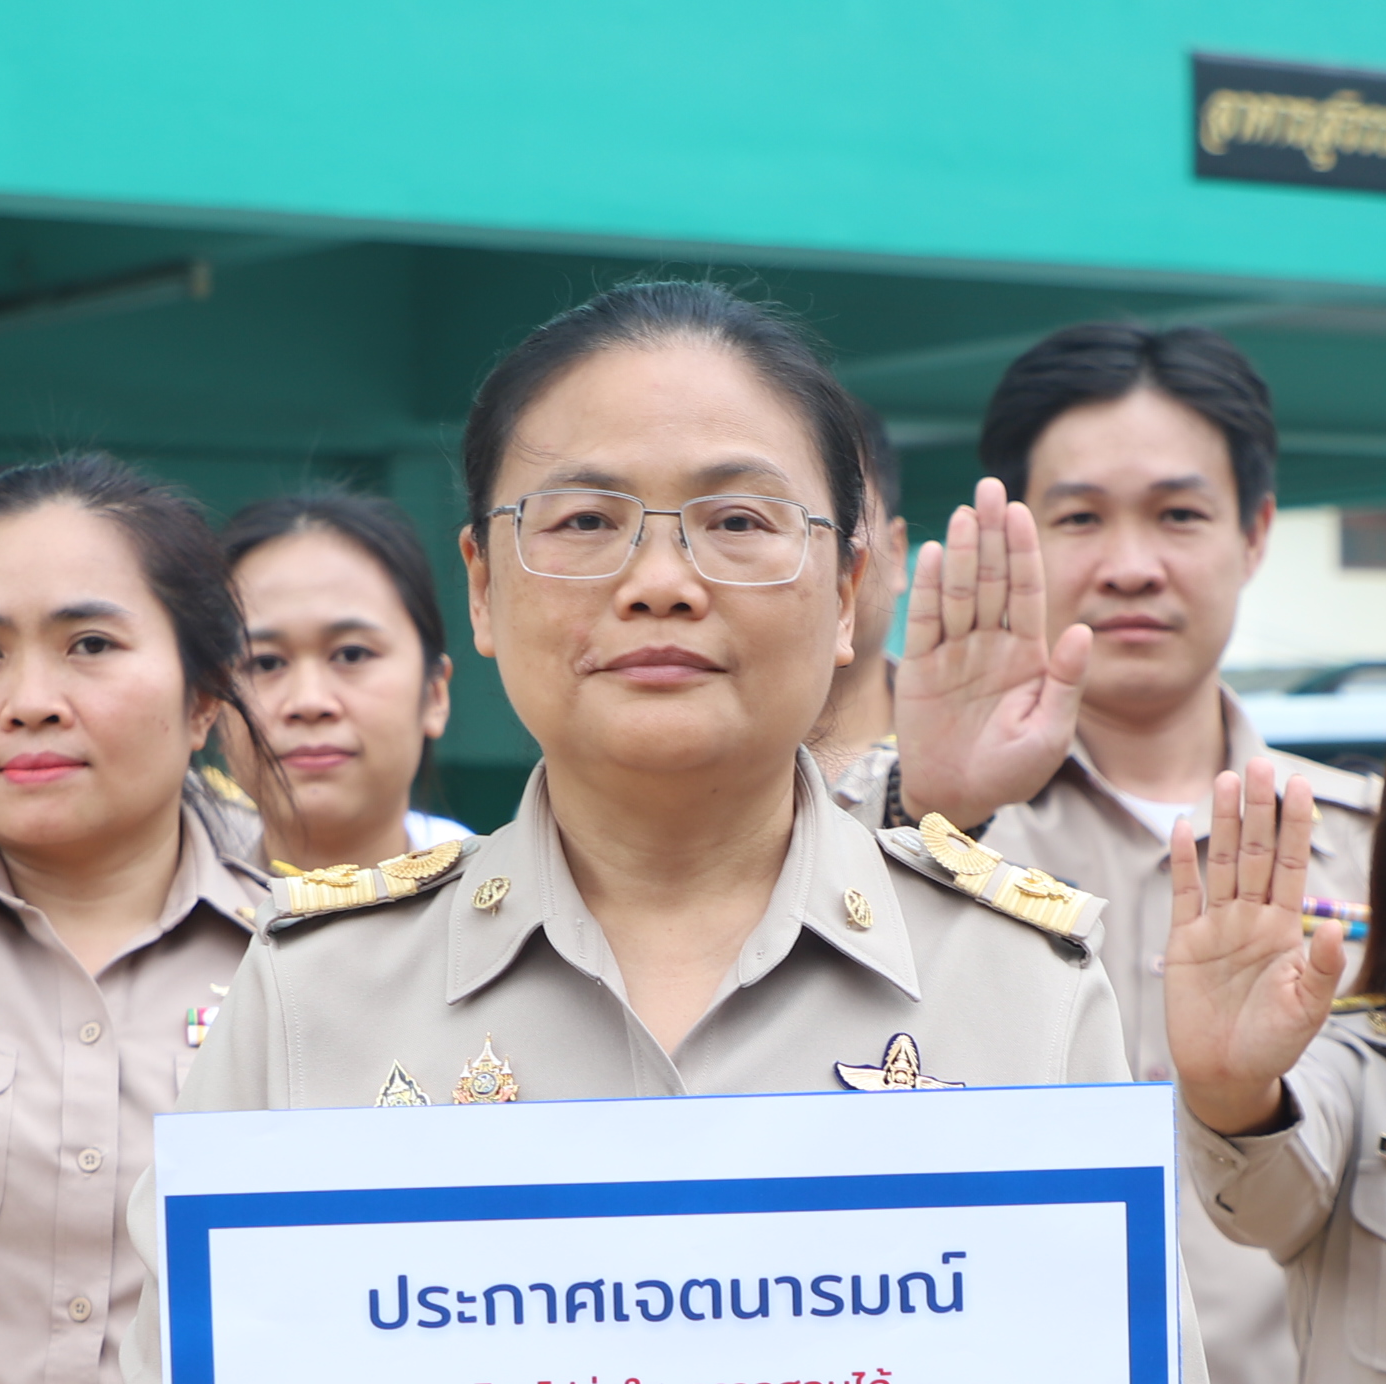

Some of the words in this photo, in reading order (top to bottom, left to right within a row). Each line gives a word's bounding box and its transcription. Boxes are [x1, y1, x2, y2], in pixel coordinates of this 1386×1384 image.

[369, 1252, 967, 1330] ประกาศเจตนารมณ์
